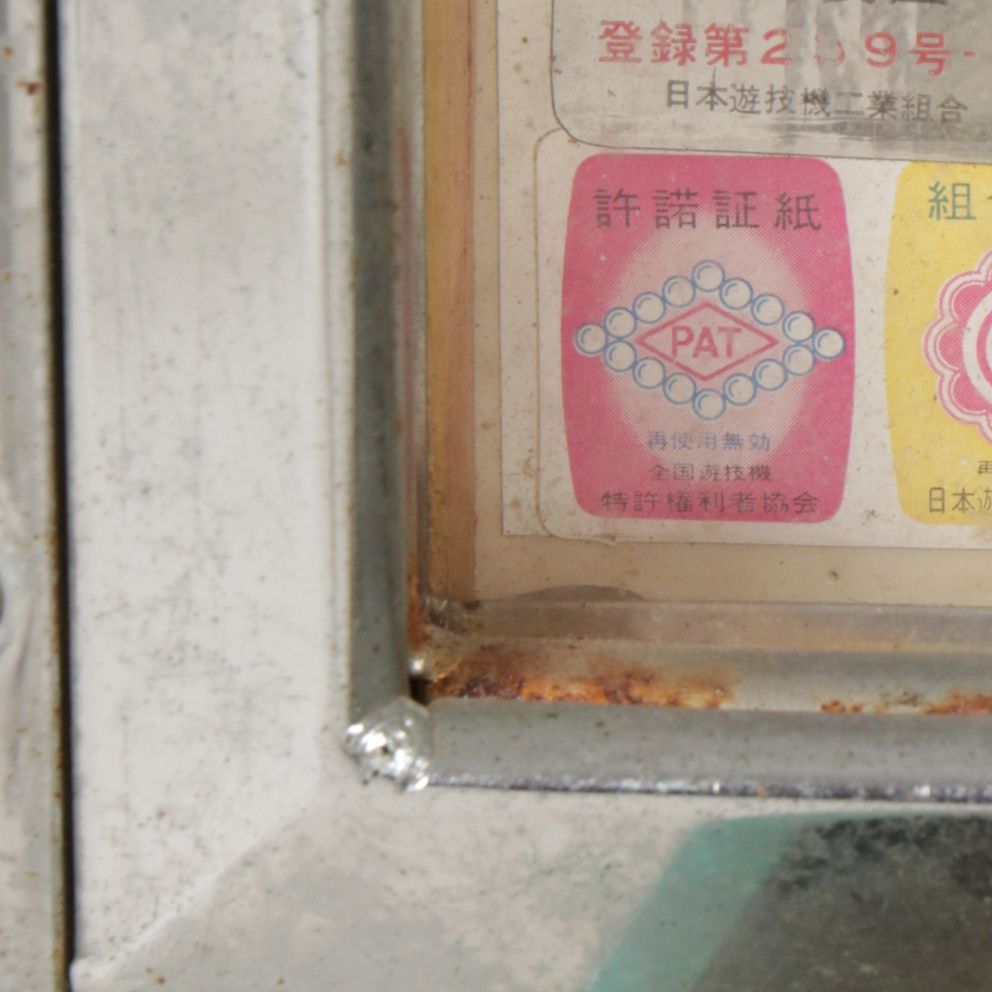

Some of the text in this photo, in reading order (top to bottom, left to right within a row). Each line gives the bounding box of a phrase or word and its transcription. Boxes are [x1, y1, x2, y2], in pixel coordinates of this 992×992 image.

[666, 79, 969, 125] 日本遊技機工業組合
[594, 187, 822, 232] 許諾証紙
[671, 325, 743, 359] PAT
[648, 431, 771, 452] 再使用無効
